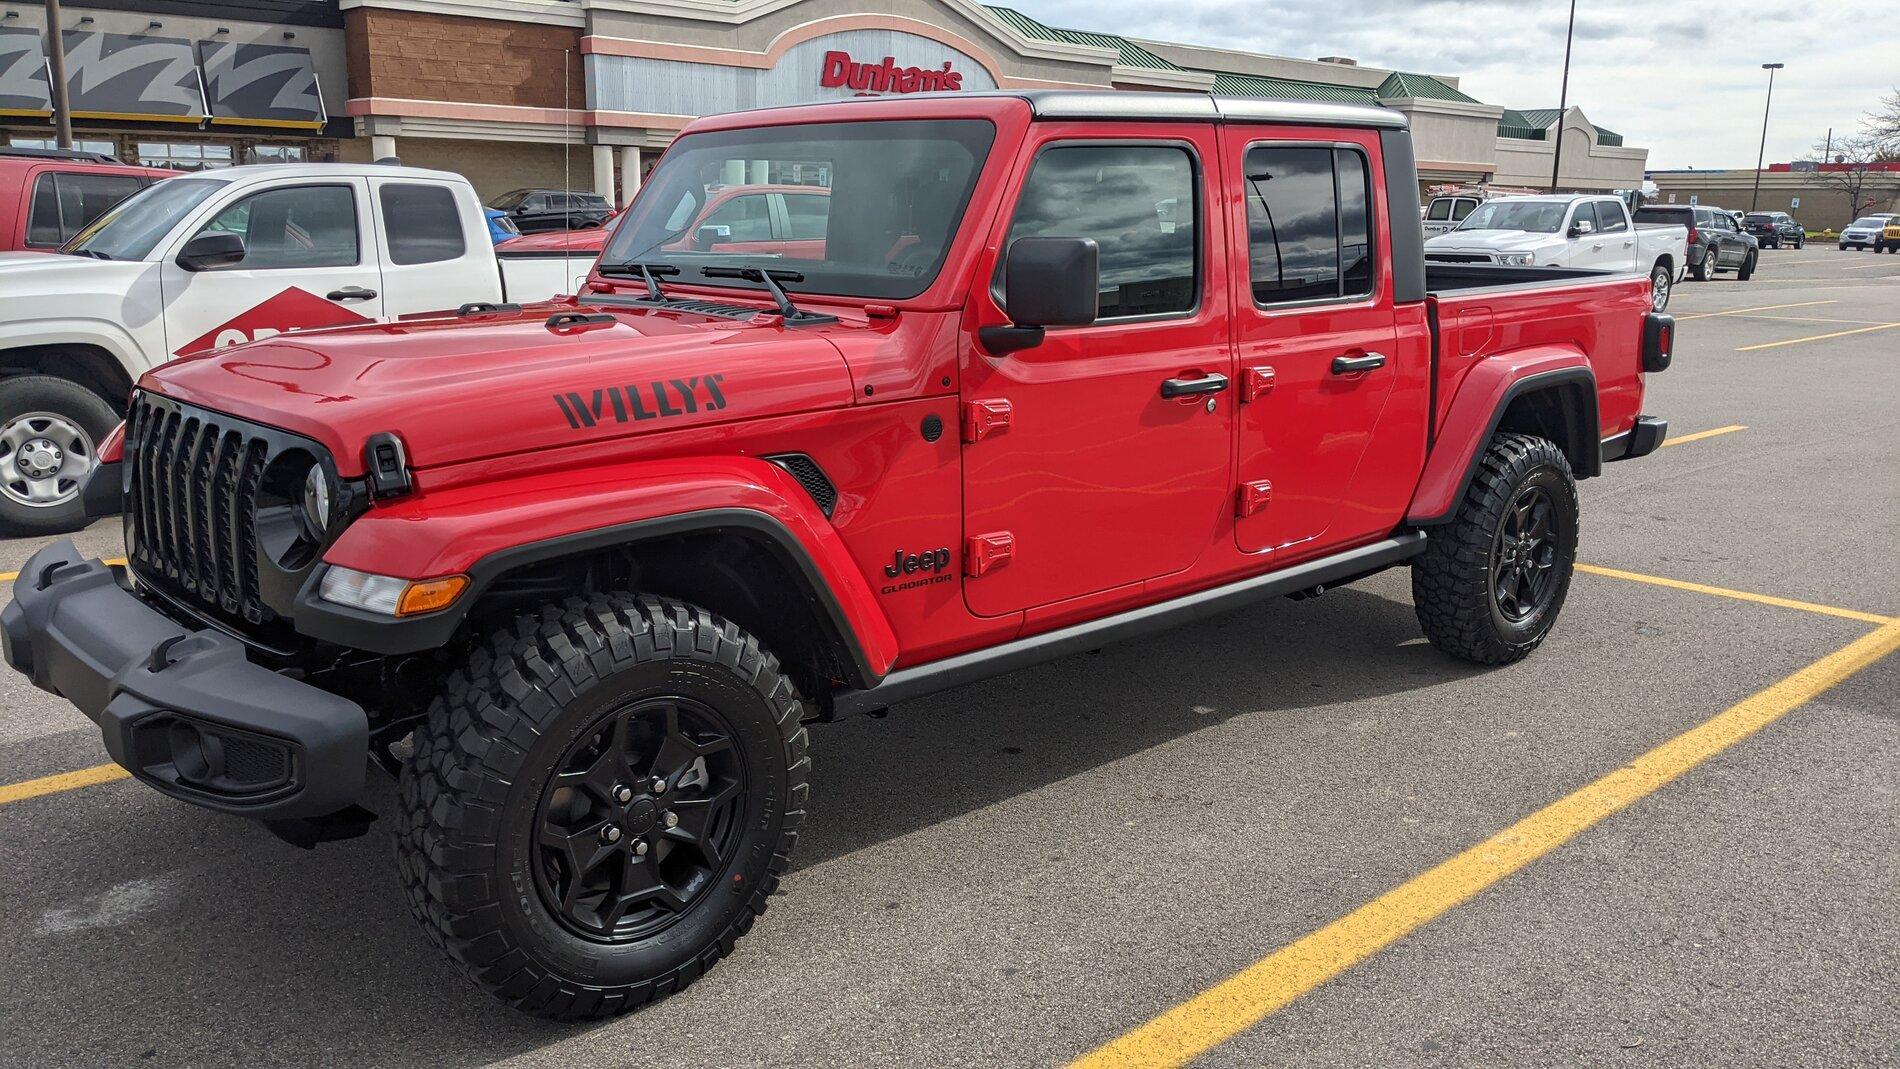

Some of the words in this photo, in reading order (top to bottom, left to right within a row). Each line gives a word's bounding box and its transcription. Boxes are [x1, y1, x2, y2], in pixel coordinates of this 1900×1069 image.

[821, 50, 963, 93] Dunham's
[553, 373, 727, 429] WILLYS
[884, 547, 951, 578] Jeep
[880, 573, 952, 595] GLADIATOR
